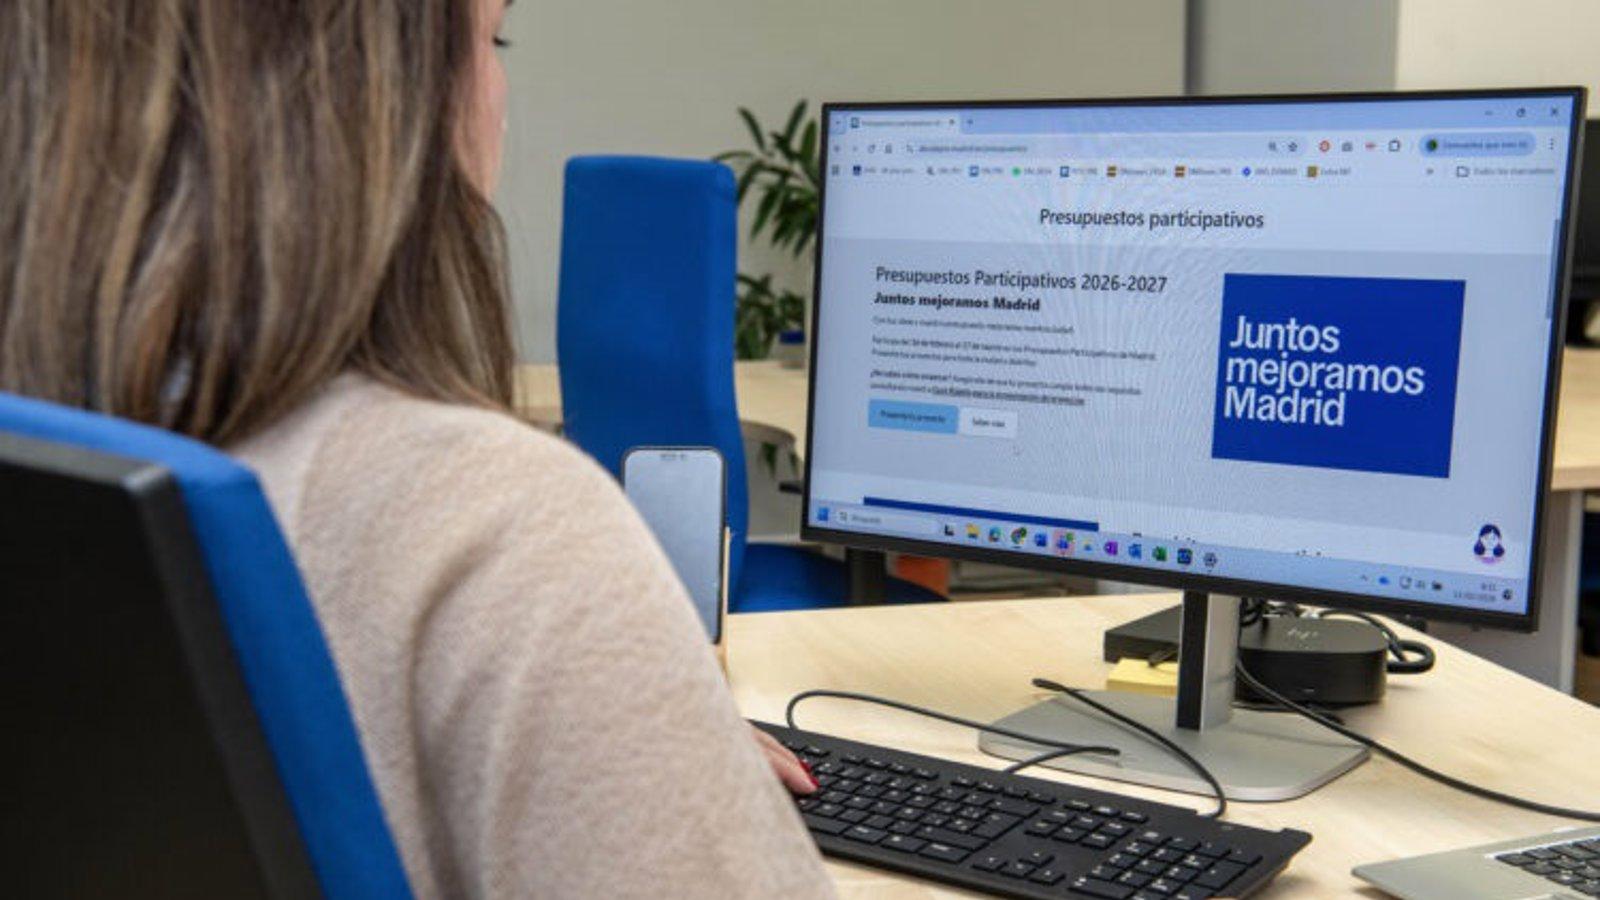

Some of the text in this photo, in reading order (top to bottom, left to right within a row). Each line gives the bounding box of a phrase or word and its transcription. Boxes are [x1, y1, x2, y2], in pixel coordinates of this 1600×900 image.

[1039, 207, 1265, 230] Presupuestos participativos
[875, 265, 1168, 293] Presupuestos Participativos 2026-2027
[873, 292, 1041, 312] Juntos mejoramos Madrid
[1229, 315, 1341, 353] Juntos
[1225, 352, 1426, 395] mejoramos
[1223, 385, 1347, 426] Madrid
